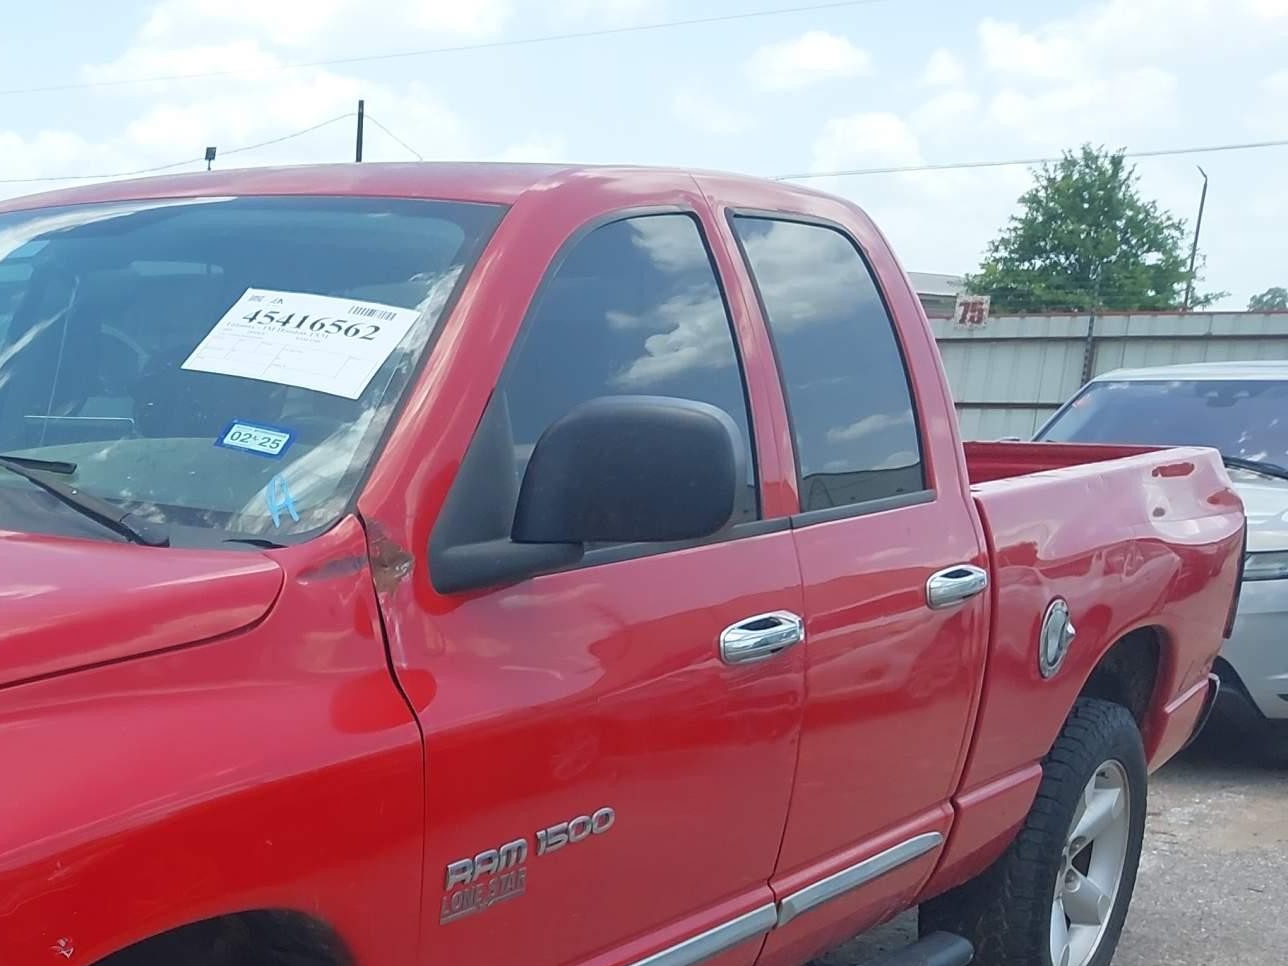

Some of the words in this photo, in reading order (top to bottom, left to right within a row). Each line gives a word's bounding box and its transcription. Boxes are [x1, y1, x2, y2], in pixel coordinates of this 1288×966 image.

[242, 308, 382, 342] 45416562
[445, 837, 528, 892] RAM
[536, 806, 617, 857] 1500
[441, 882, 485, 916] LONE
[487, 866, 527, 898] STAR
